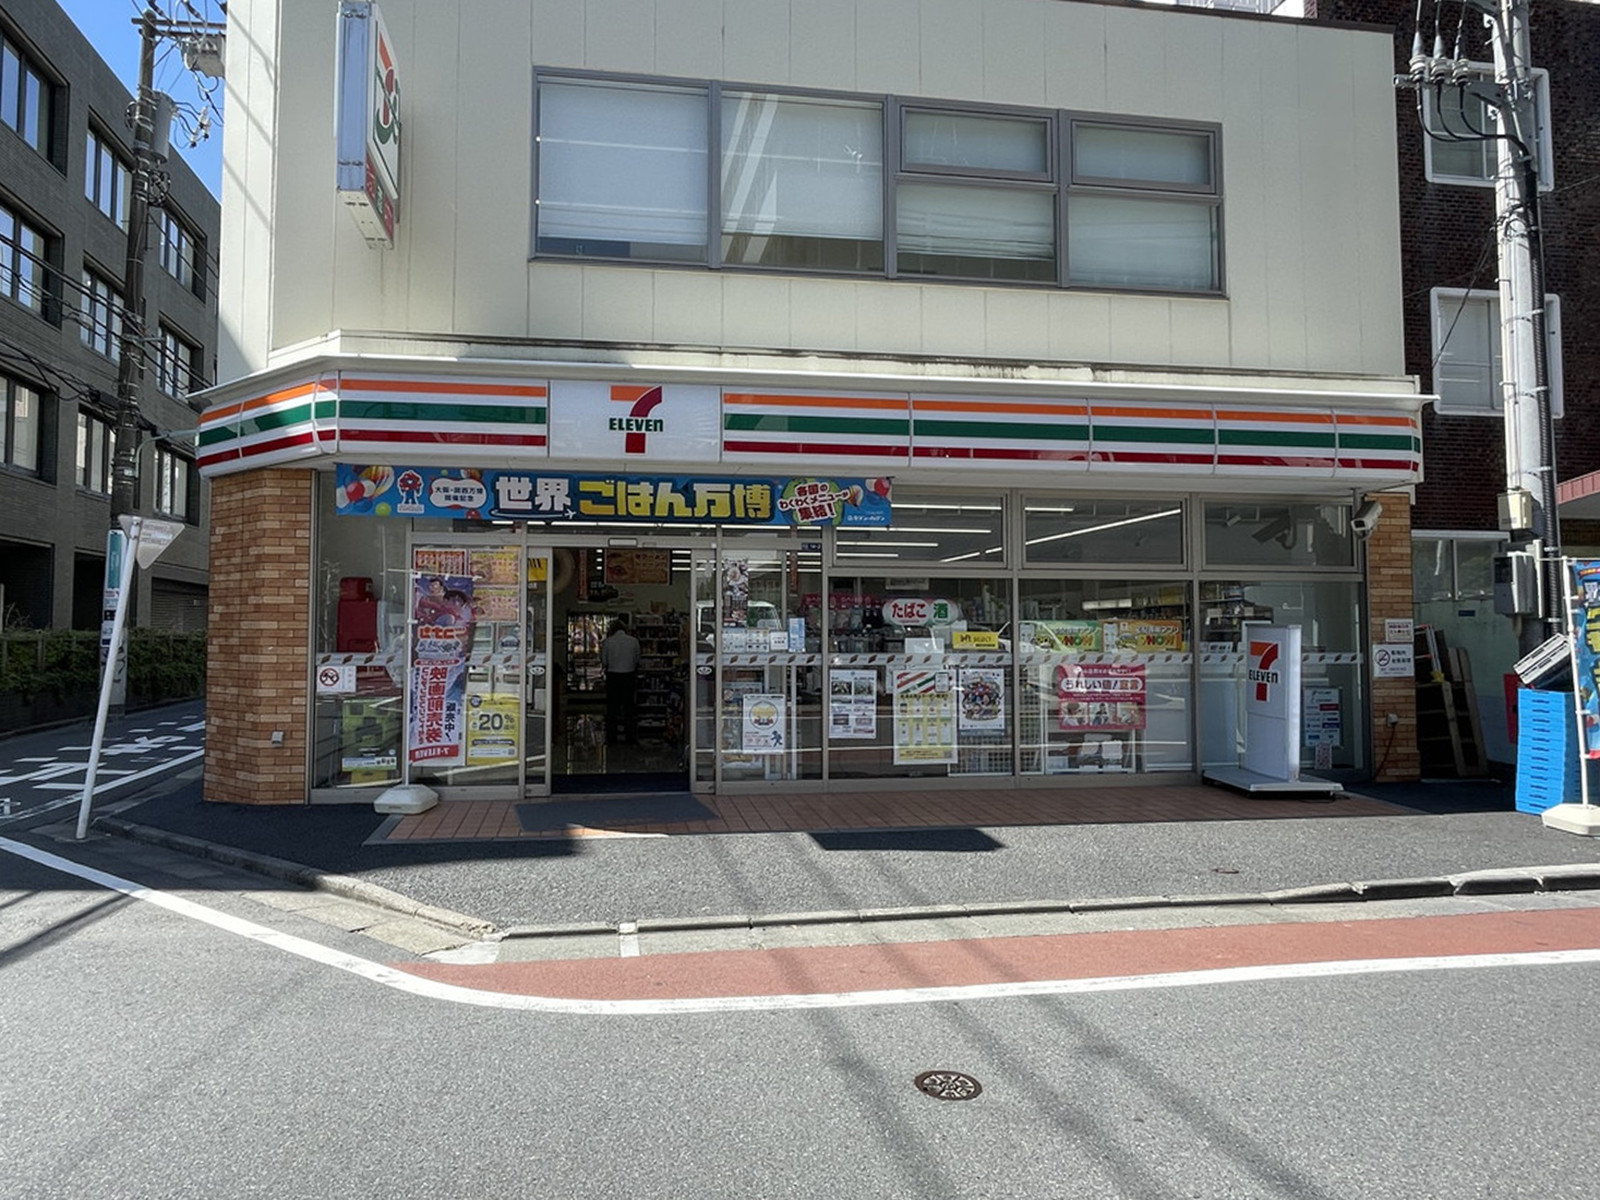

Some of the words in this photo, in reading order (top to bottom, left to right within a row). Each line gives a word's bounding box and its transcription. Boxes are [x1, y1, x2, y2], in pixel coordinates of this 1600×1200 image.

[495, 476, 771, 518] 世界ごはん万博
[892, 602, 927, 619] たばこ
[933, 602, 949, 619] 酒
